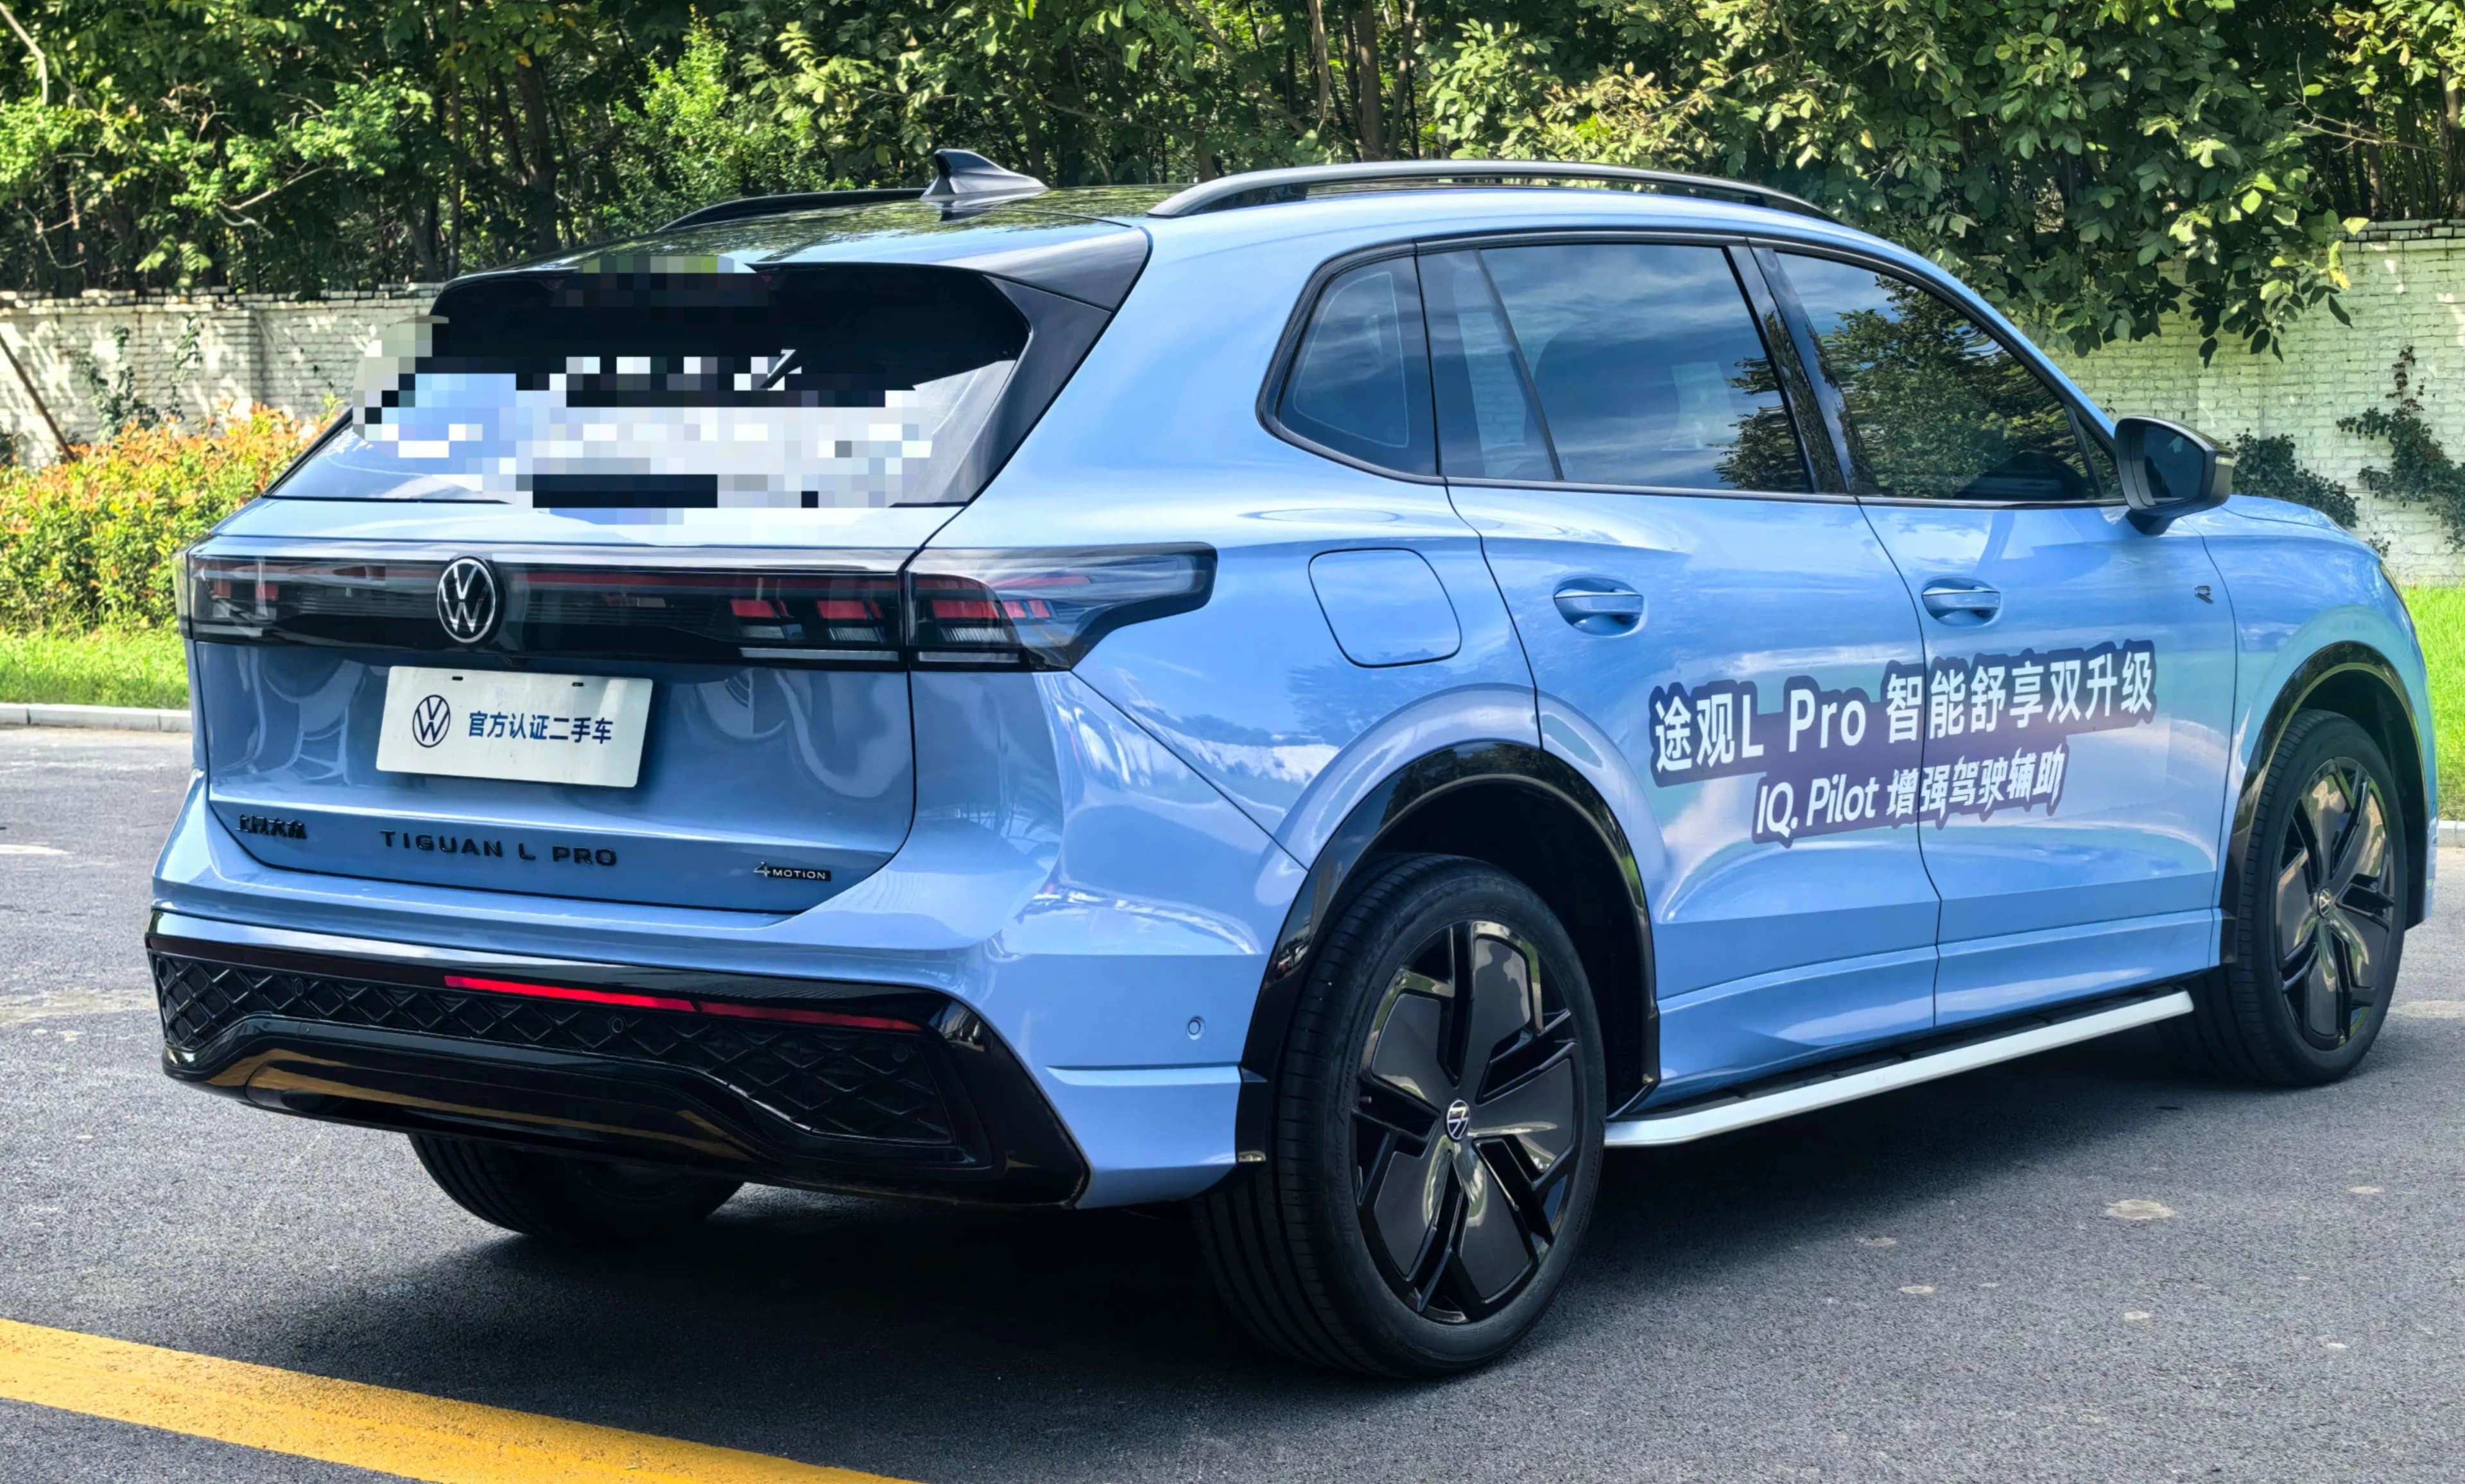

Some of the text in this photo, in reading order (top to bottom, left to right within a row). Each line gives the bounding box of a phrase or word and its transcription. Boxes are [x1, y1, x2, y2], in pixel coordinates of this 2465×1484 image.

[468, 711, 614, 744] 官方认证二手车
[1655, 651, 2153, 773] 途观L Pro 智能舒享双升级
[1806, 773, 1880, 827] Pilot
[1886, 743, 2066, 819] 增强驾驶辅助
[380, 829, 618, 867] TIGUAN L PRO
